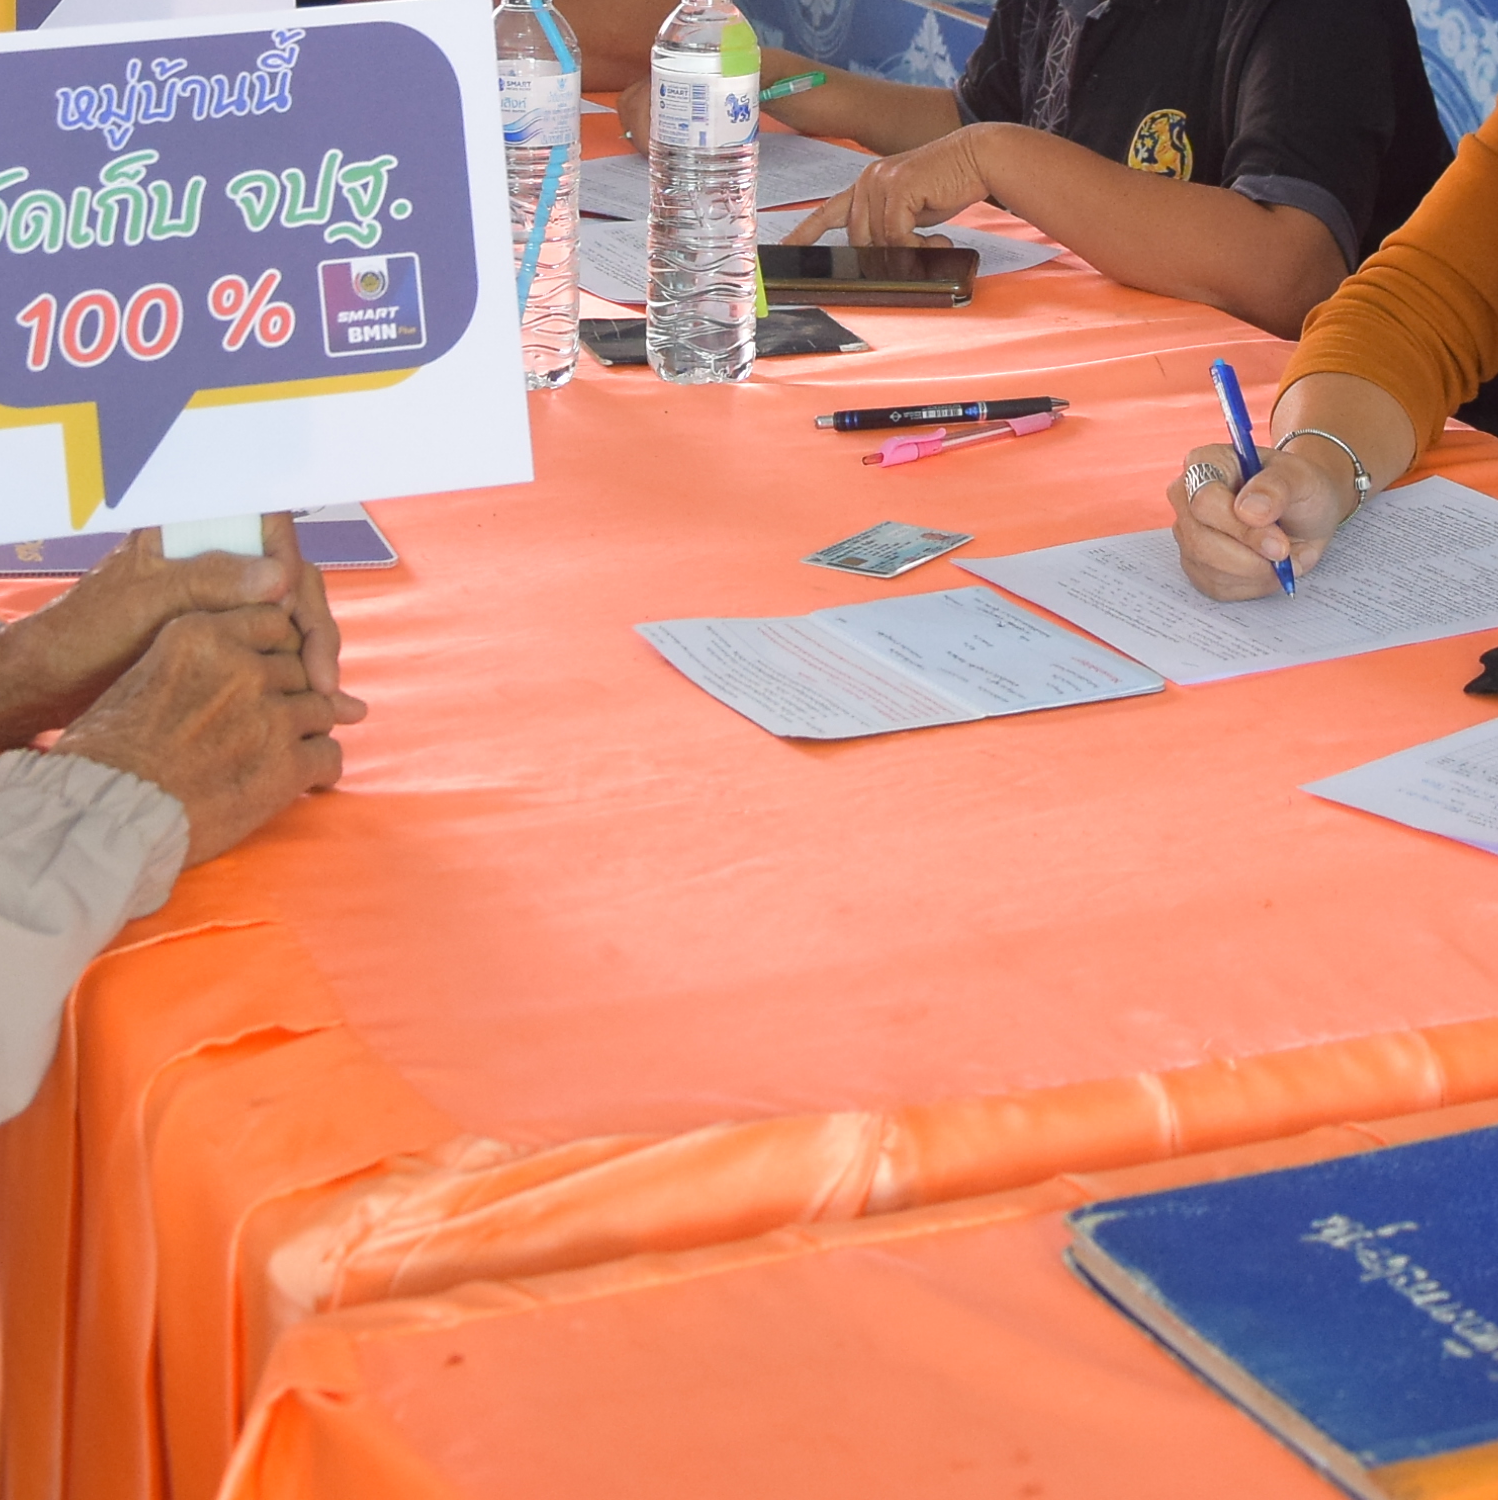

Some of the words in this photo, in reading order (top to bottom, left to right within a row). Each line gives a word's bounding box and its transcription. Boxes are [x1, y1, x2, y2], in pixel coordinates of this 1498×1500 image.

[56, 27, 308, 151] หมู่บ้านนี้
[506, 80, 532, 88] SMART
[666, 88, 689, 97] SMART
[501, 96, 528, 109] สิงห์
[225, 149, 414, 248] จปฐ.
[16, 282, 184, 374] 100
[207, 270, 296, 354] %
[336, 305, 400, 324] SMART
[347, 323, 398, 344] BMN
